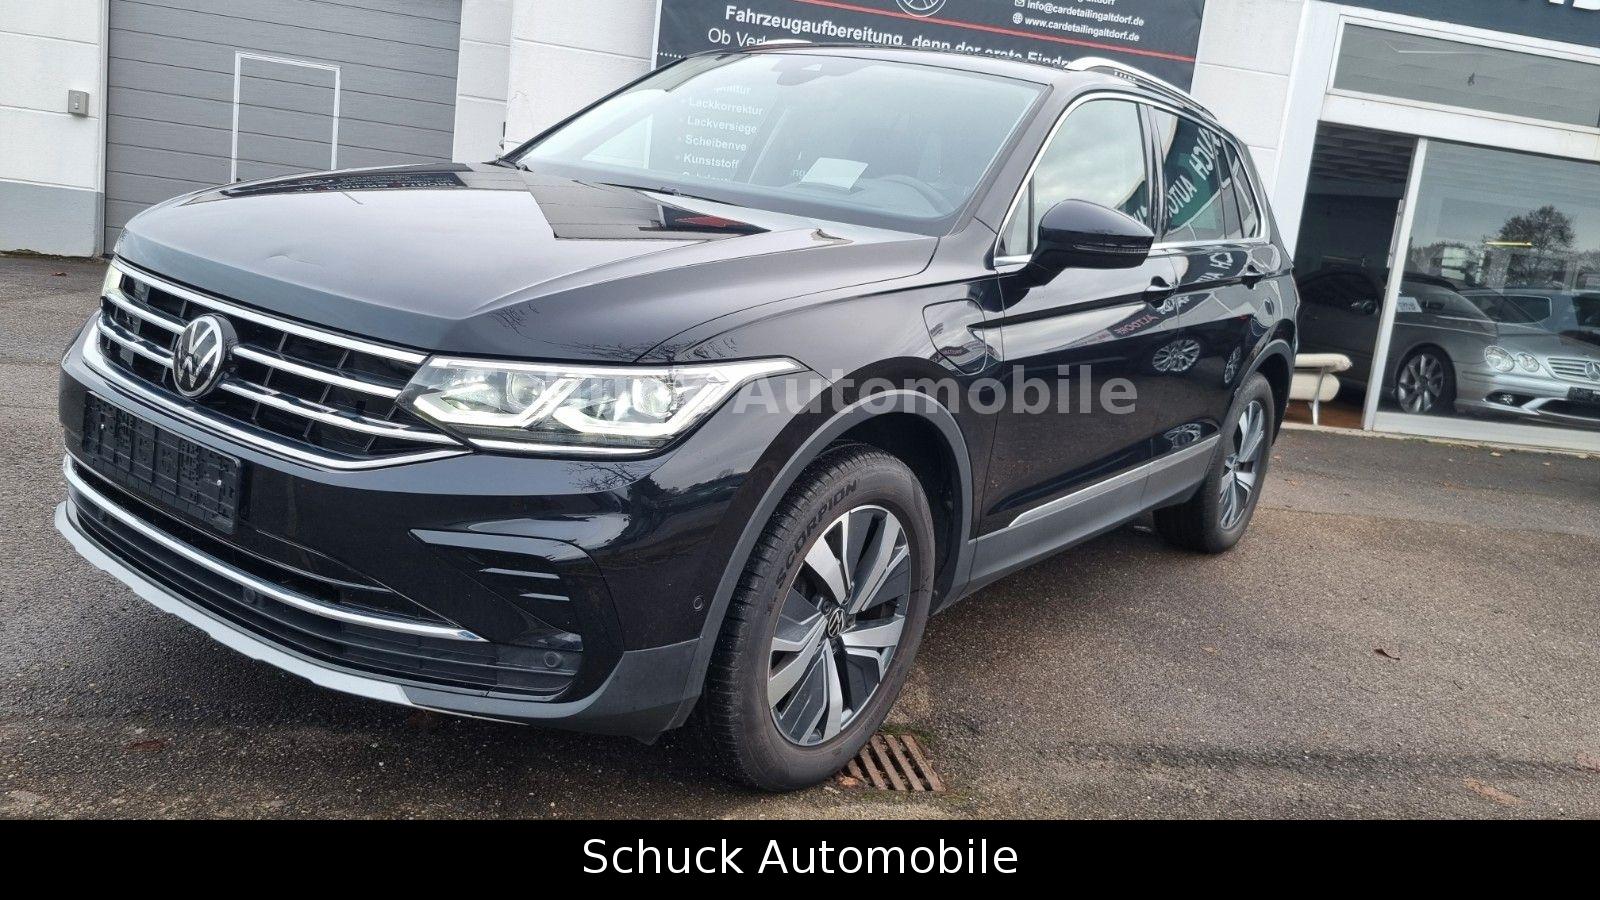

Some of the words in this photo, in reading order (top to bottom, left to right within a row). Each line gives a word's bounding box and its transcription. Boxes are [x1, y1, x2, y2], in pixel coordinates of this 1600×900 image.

[1026, 0, 1145, 27] info@cardetailingaltdorf.de
[708, 27, 731, 45] Ob
[1024, 17, 1140, 42] www.cardetailingaltdorf.de
[689, 97, 764, 116] Lackkorrektur
[682, 152, 740, 170] Kunststoff
[775, 480, 858, 590] SCORPION
